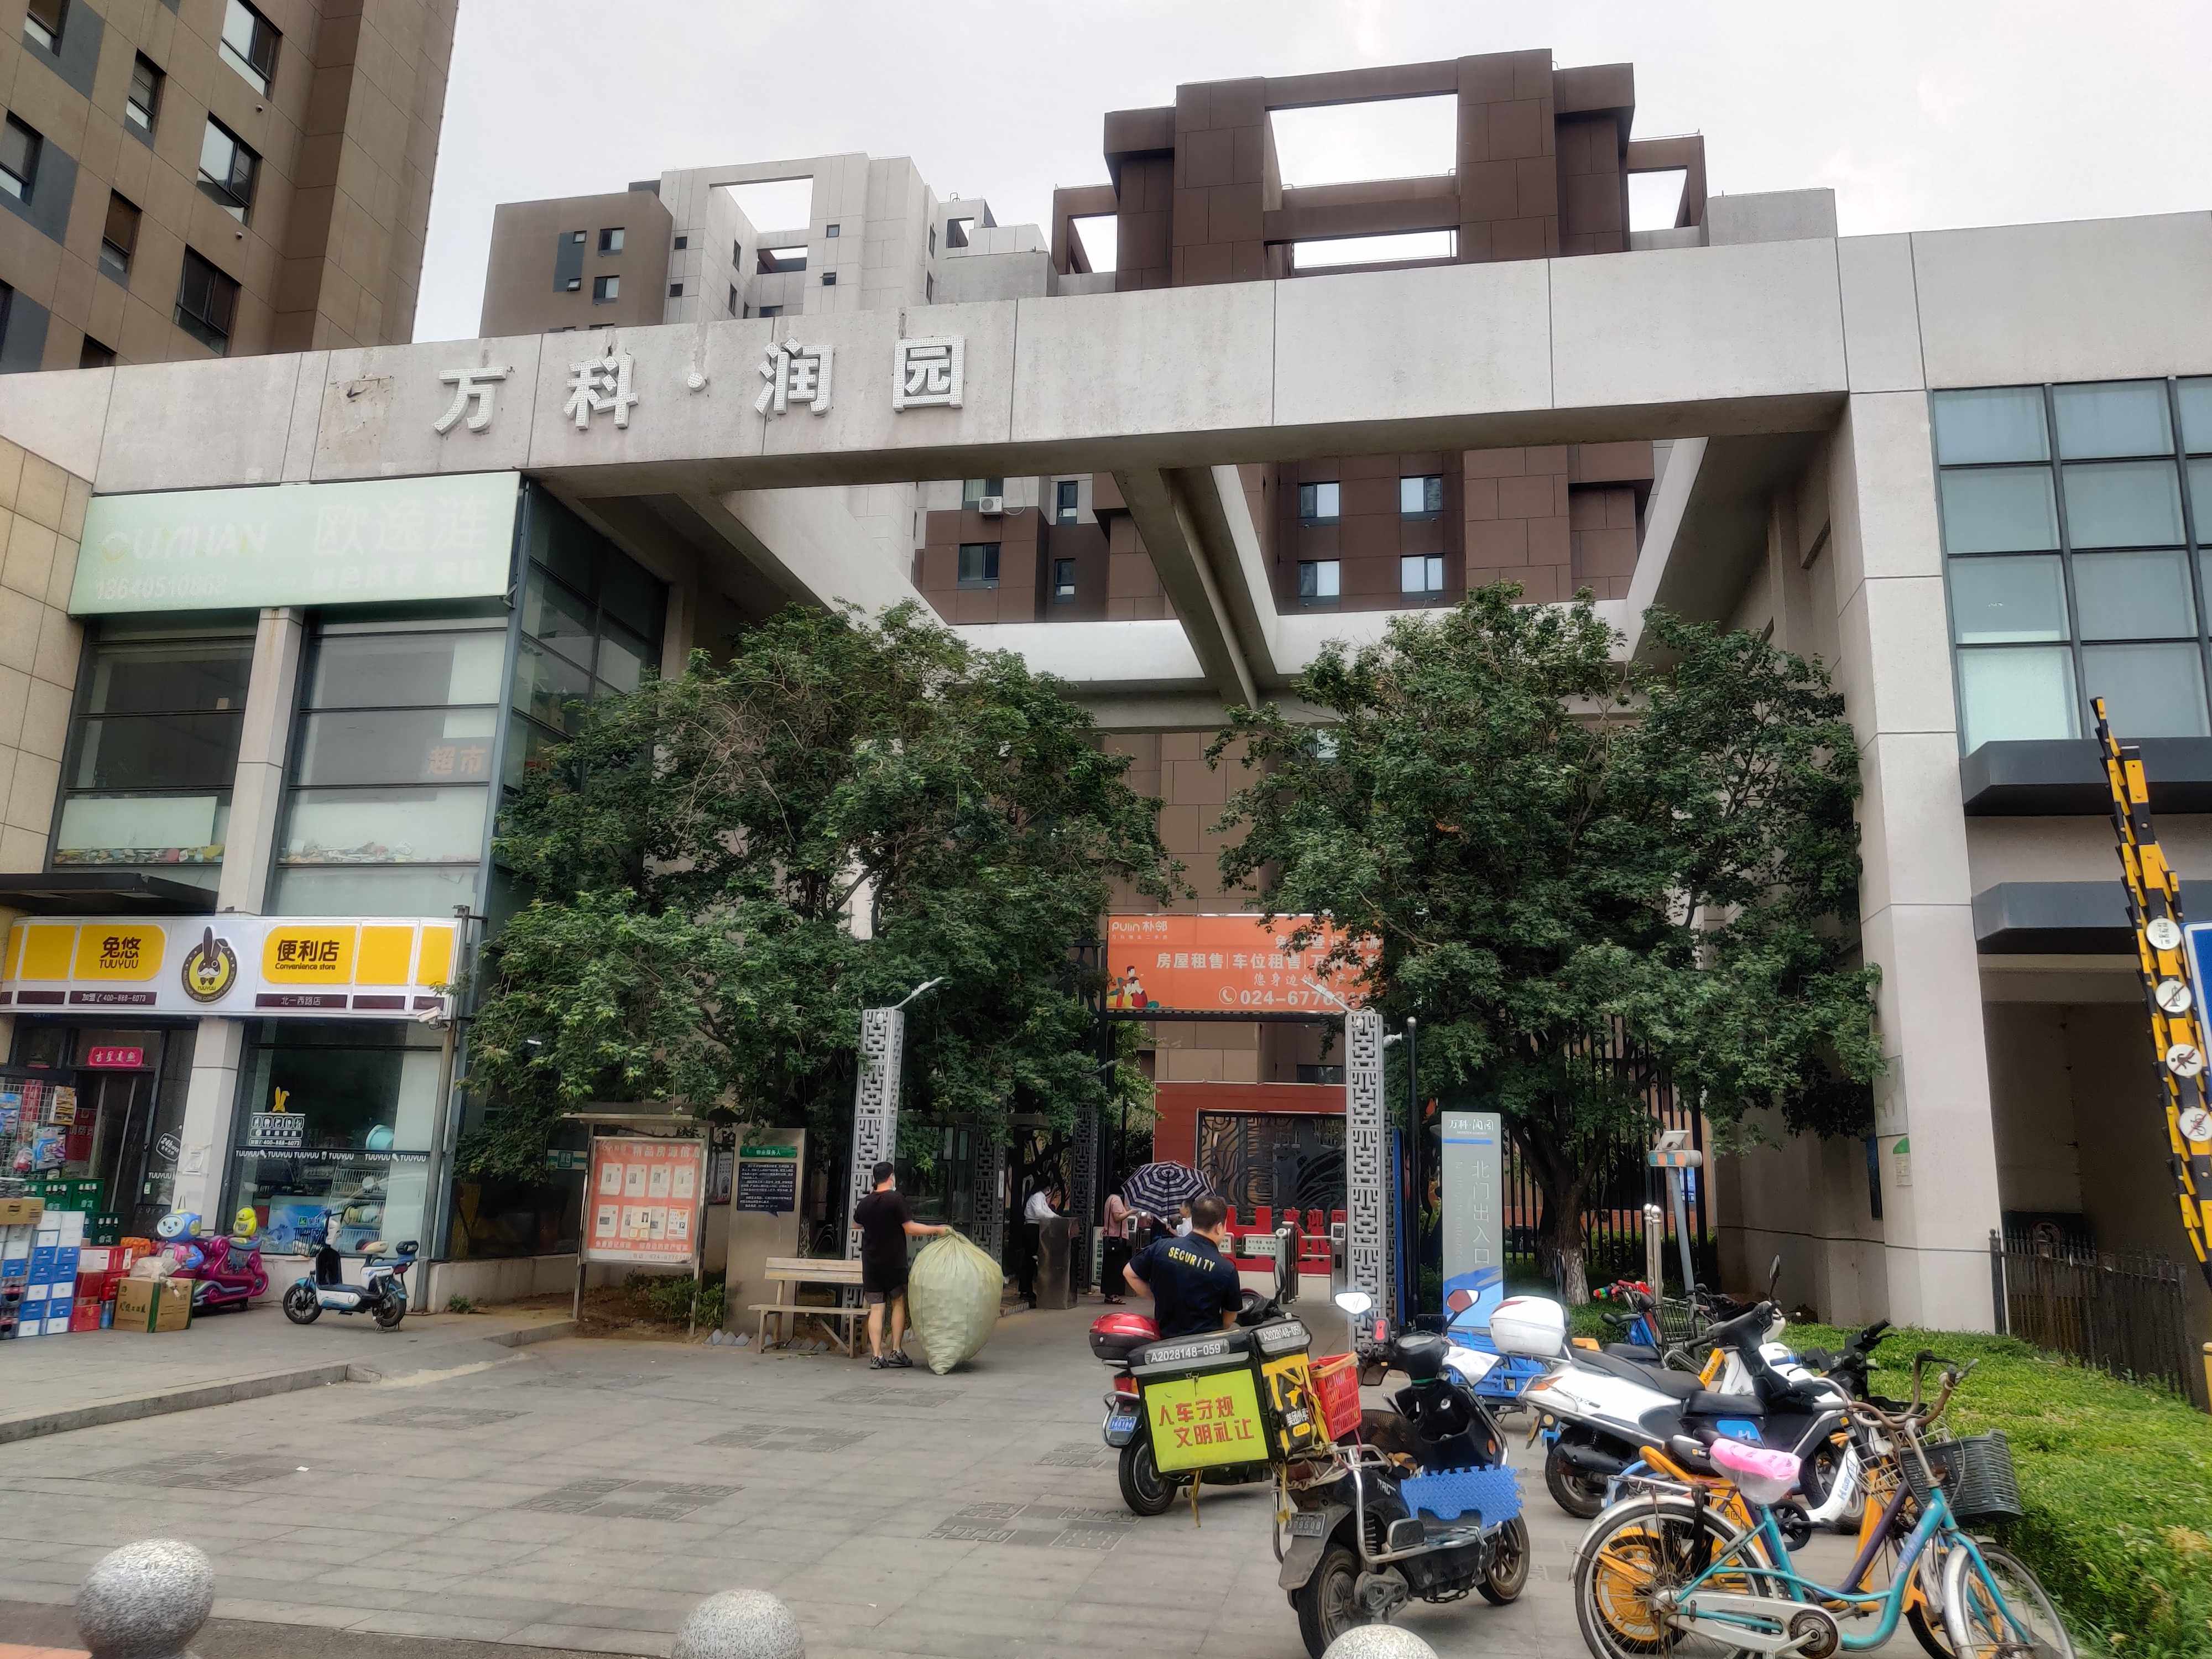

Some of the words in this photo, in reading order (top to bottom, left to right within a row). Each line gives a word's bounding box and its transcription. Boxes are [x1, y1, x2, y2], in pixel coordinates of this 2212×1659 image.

[428, 745, 487, 774] 超市
[277, 939, 340, 962] 便利店
[1156, 952, 1223, 969] 房屋租售
[1233, 953, 1301, 969] 车位租售
[99, 959, 139, 969] TUUYUU
[281, 997, 321, 1005] 北一西路店
[1472, 1160, 1491, 1264] 北门出入口
[1168, 1246, 1216, 1271] SECURITY
[1173, 1418, 1254, 1448] 文明礼让
